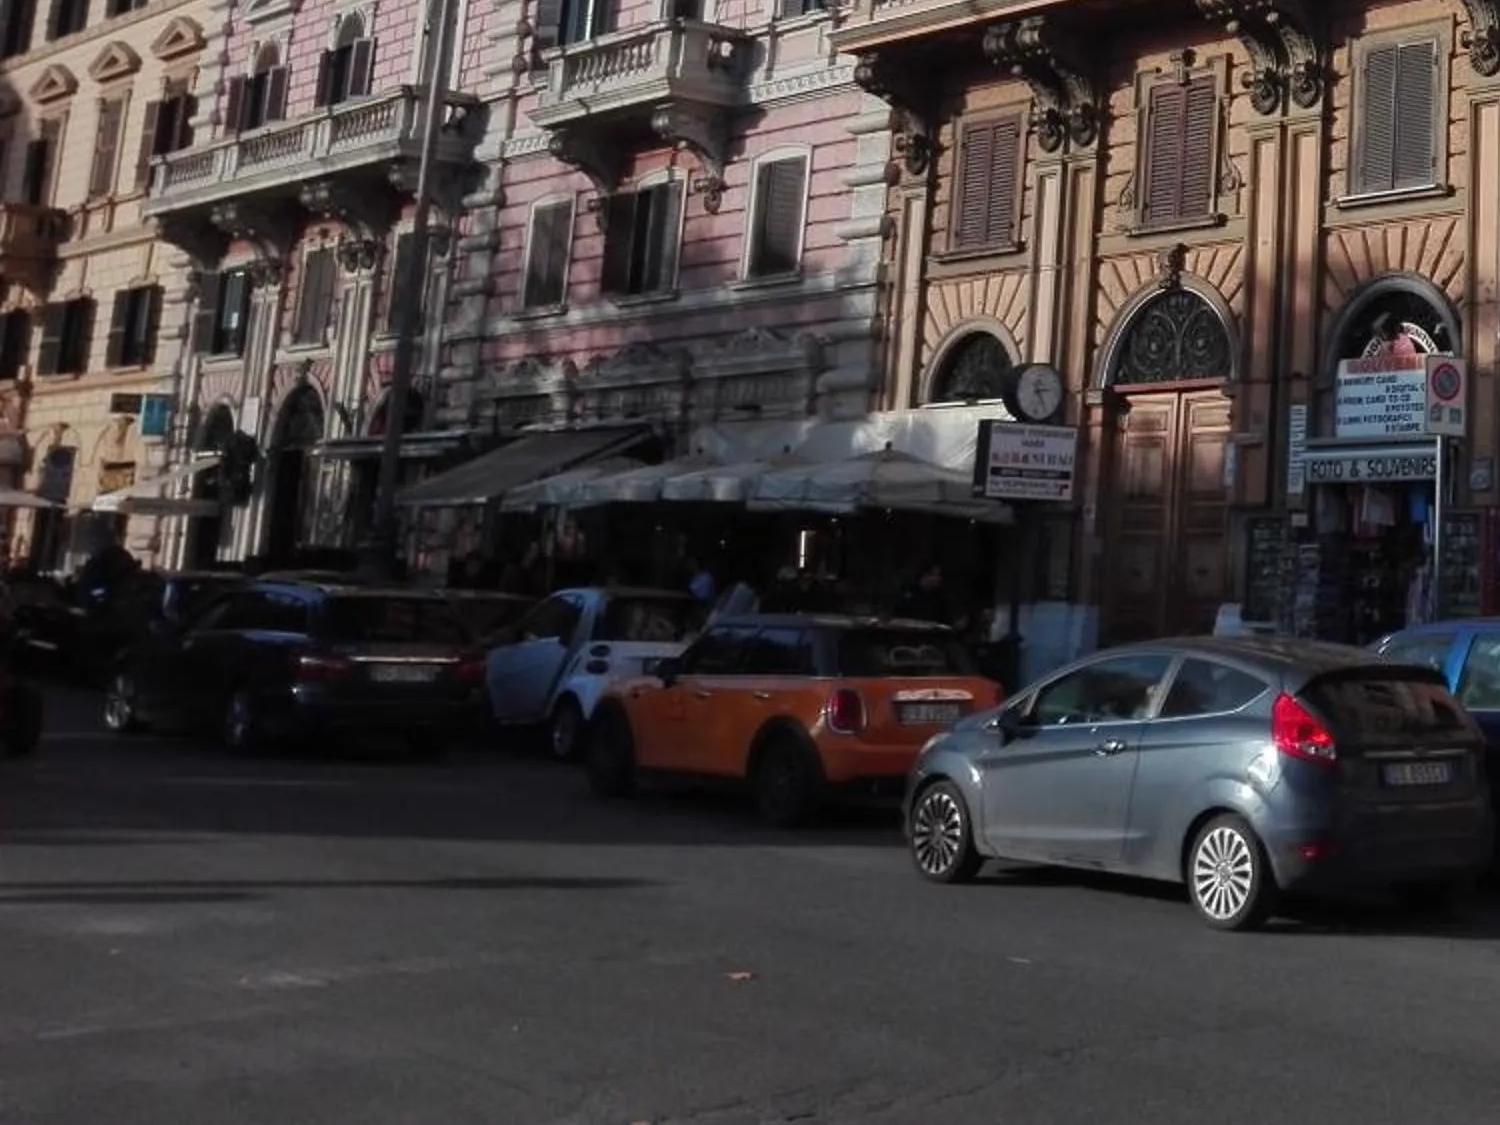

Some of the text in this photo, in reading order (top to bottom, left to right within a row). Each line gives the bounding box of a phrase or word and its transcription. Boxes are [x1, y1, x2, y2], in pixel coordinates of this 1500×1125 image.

[1311, 457, 1437, 478] FOTO & SOUVENIRS
